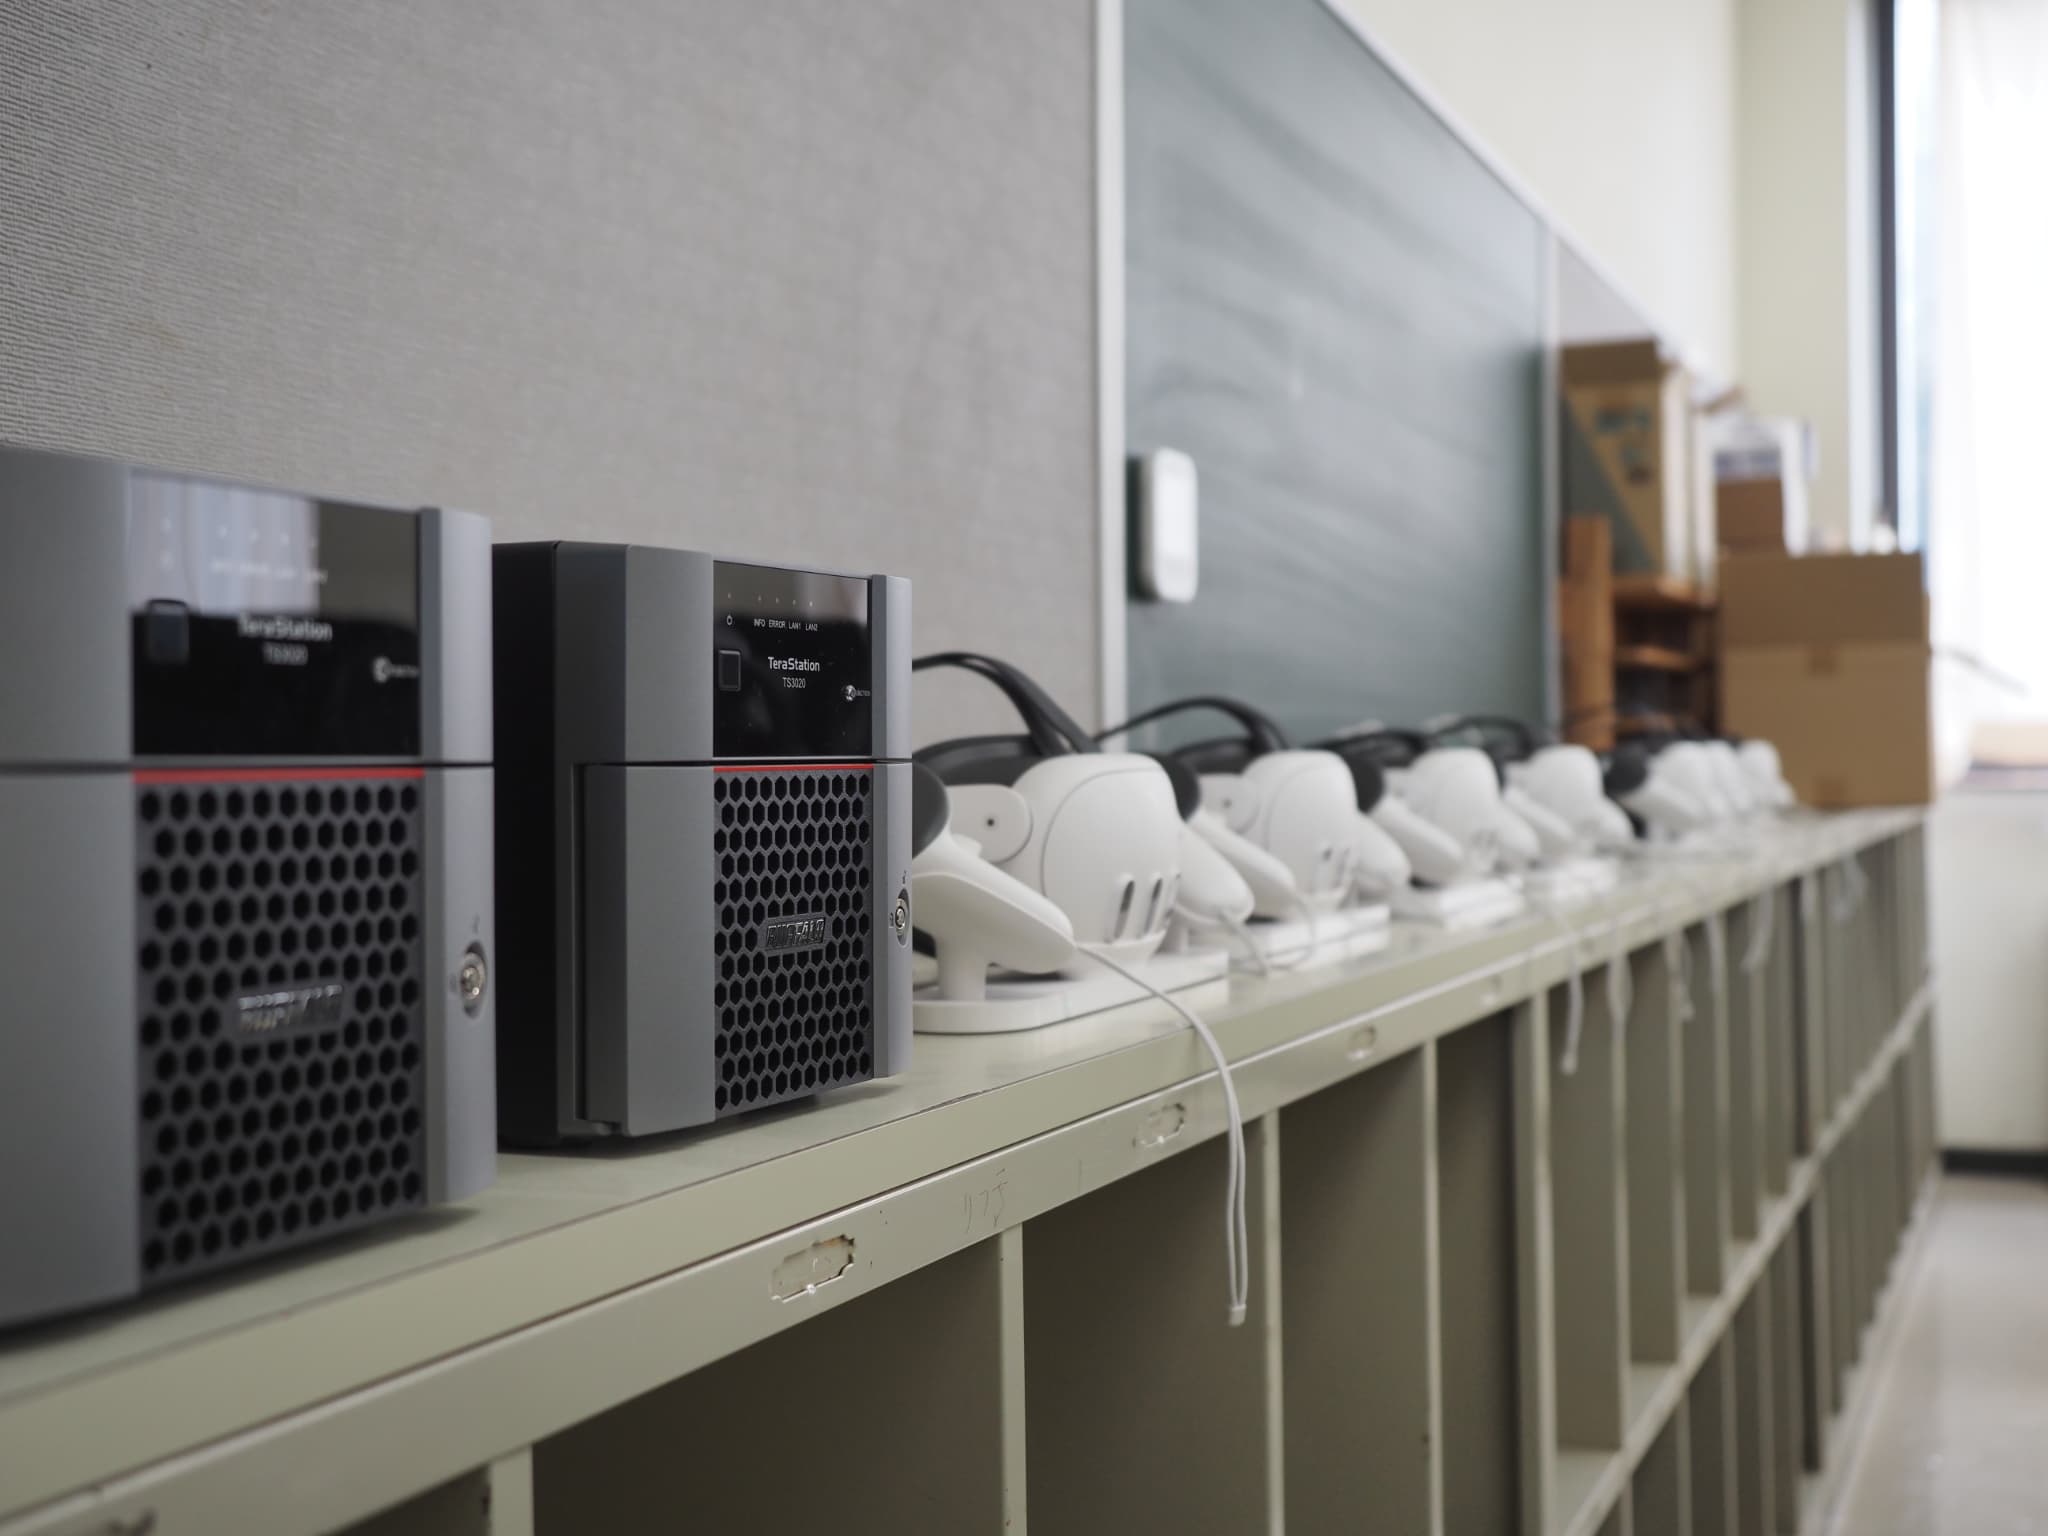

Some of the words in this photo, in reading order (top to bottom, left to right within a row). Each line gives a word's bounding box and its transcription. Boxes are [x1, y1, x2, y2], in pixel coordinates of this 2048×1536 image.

[753, 618, 766, 628] INFO
[768, 619, 786, 629] ERROR
[788, 621, 801, 630] LAN1
[805, 623, 818, 632] LAN2
[767, 656, 820, 673] TeraStation
[782, 677, 806, 689] TS3020
